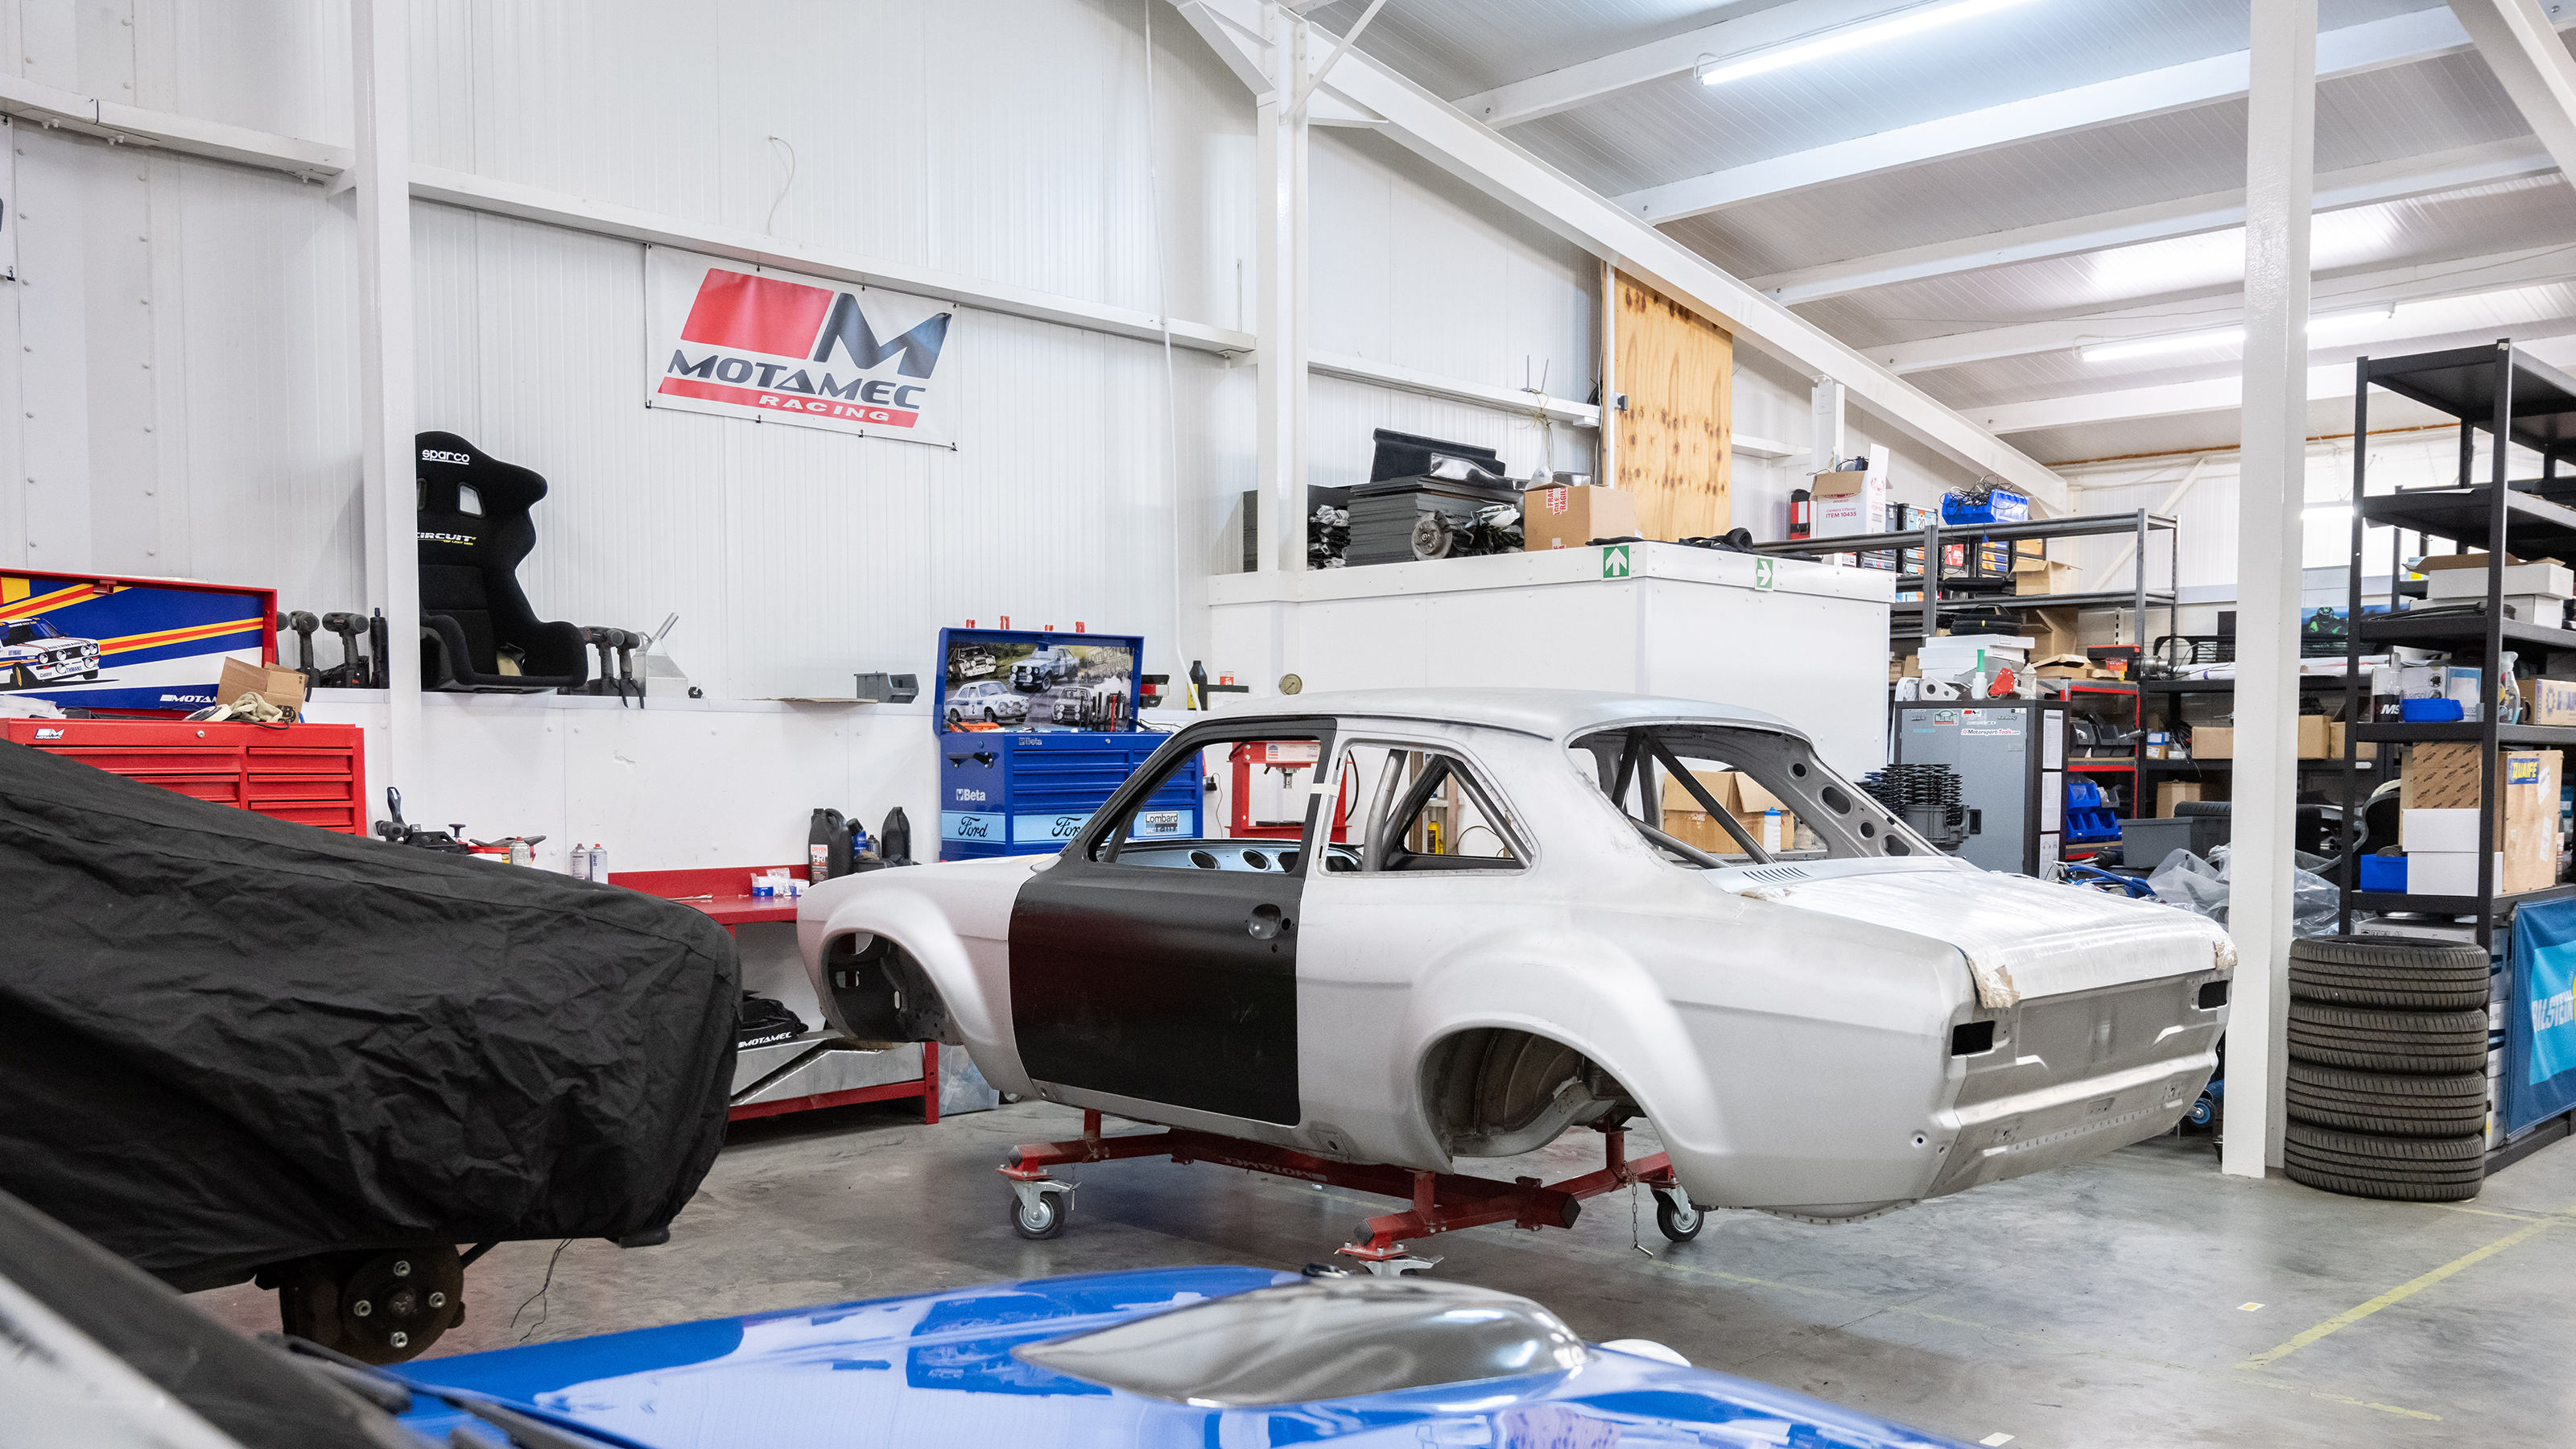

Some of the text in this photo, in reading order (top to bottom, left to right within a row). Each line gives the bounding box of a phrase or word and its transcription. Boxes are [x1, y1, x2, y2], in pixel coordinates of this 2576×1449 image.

[667, 349, 927, 410] MOTAMEC
[758, 394, 890, 422] RACING
[422, 449, 470, 463] sparco
[1026, 737, 1042, 745] Beta
[2512, 762, 2537, 779] QUAIFE
[964, 789, 986, 802] Beta
[1051, 816, 1082, 837] For
[1146, 814, 1178, 823] Lombard
[958, 816, 989, 838] Ford
[742, 1031, 792, 1047] MOTAMEC
